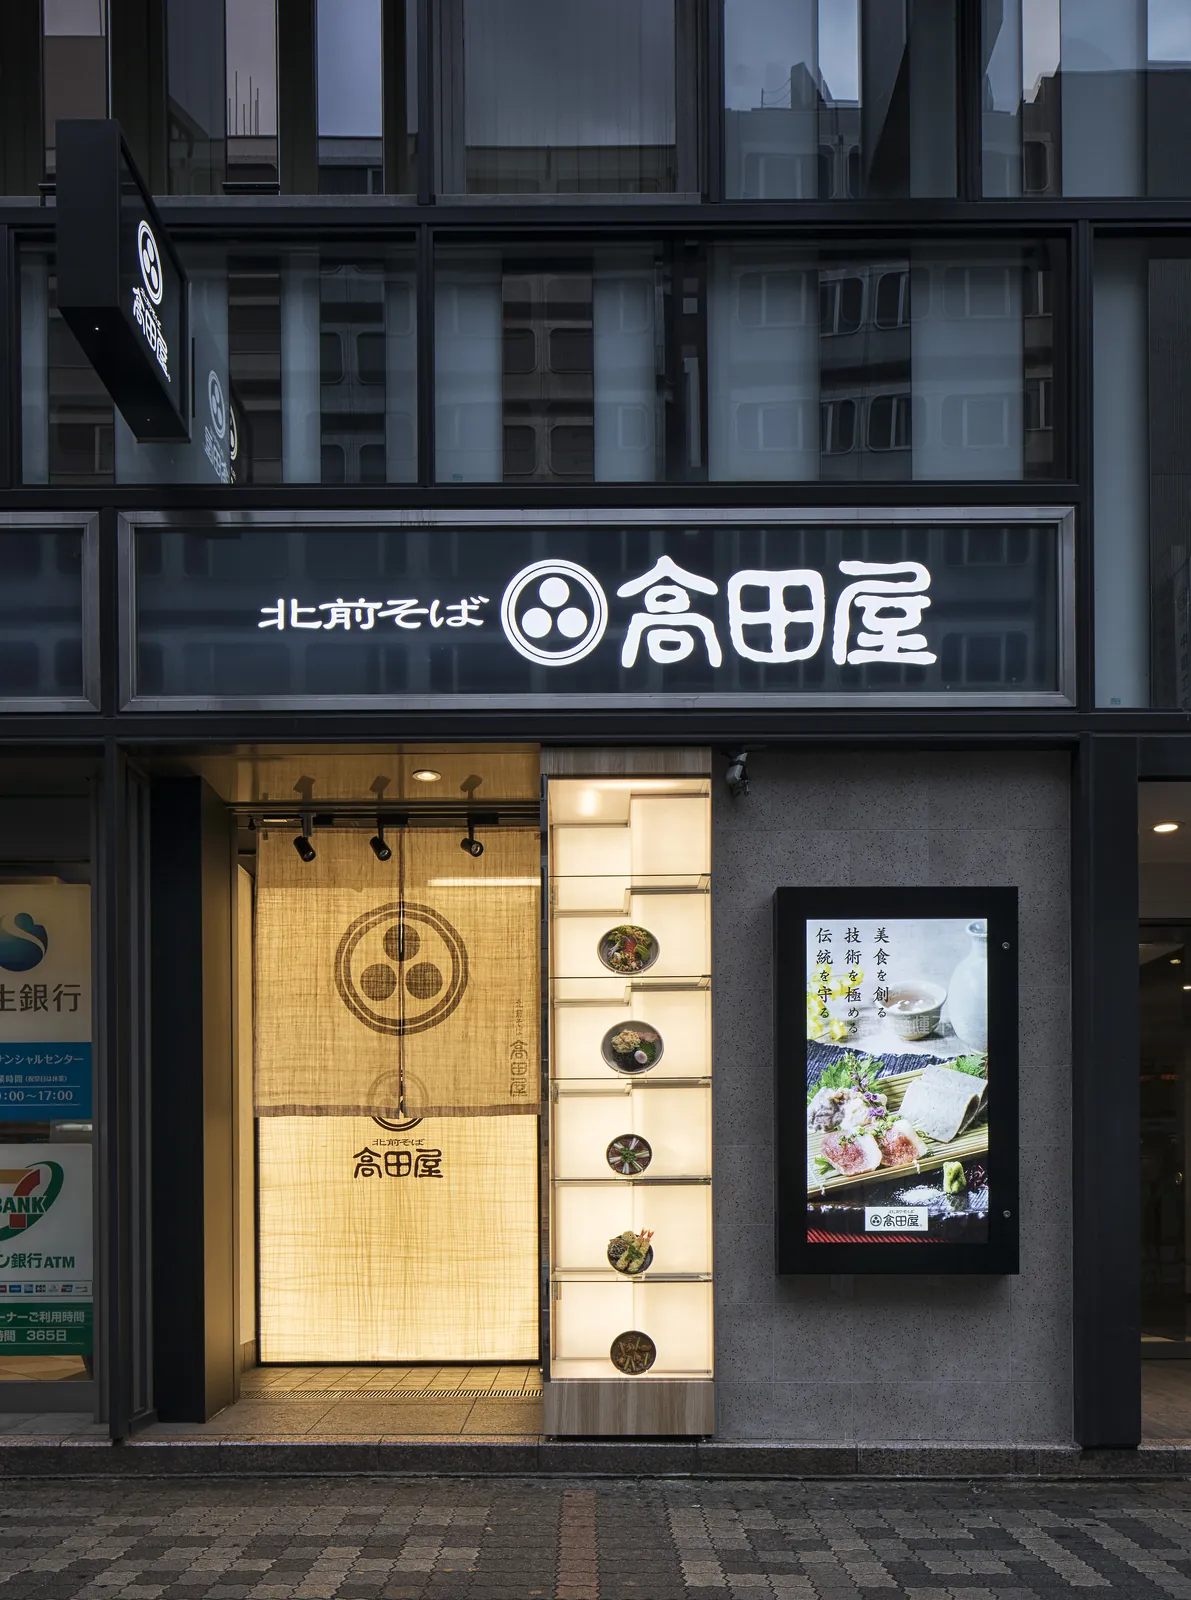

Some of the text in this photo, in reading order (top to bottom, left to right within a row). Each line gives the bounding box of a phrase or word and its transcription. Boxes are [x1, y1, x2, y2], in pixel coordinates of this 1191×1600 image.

[258, 554, 937, 668] 北前そば 高田屋
[815, 927, 833, 1019] 伝統を守る
[844, 926, 862, 1034] 技術を極める
[873, 927, 891, 1019] 美食を創る
[509, 1039, 529, 1097] 高田屋
[0, 1090, 74, 1102] :00～17:00
[372, 1138, 425, 1147] 北前そば
[353, 1146, 444, 1179] 高田屋
[0, 1196, 45, 1213] ANK
[883, 1213, 919, 1227] 高田屋
[26, 1330, 67, 1341] 365日
